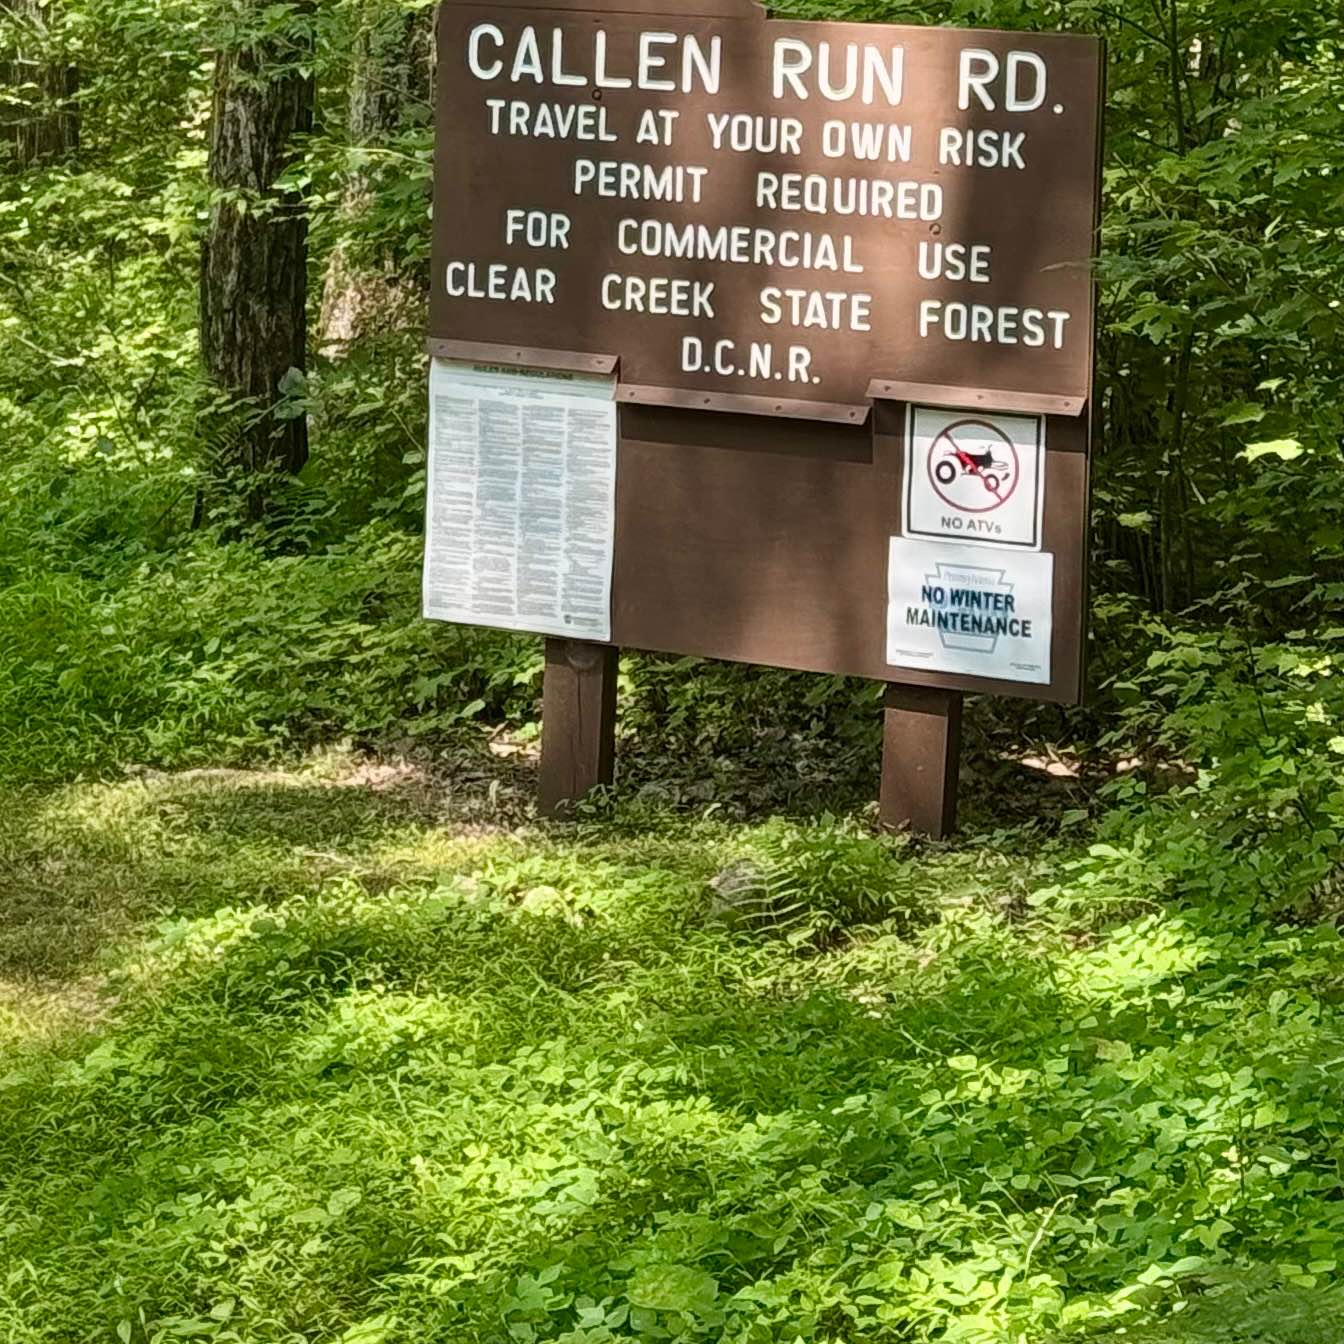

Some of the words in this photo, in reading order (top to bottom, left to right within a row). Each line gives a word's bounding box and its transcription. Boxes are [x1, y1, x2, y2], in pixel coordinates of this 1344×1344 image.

[469, 24, 721, 94] CALLEN
[774, 39, 904, 105] RUN
[958, 48, 1062, 113] RD.
[487, 100, 617, 141] TRAVEL
[637, 110, 679, 145] AT
[708, 113, 802, 154] YOUR
[823, 121, 911, 161] OWN
[939, 127, 1024, 168] RISK
[575, 160, 707, 202] PERMIT
[757, 173, 942, 220] REQUIRED
[507, 210, 570, 248] FOR
[619, 220, 864, 272] COMMERCIAL
[918, 241, 989, 282] USE
[447, 262, 555, 303] CLEAR
[602, 274, 713, 317] CREEK
[761, 288, 871, 330] STATE
[920, 300, 1069, 348] FOREST
[683, 337, 819, 383] D.C.N.R.
[941, 516, 963, 529] NO
[967, 519, 1002, 534] ATVs
[906, 607, 1033, 638] MAINTENANCE
[922, 585, 945, 605] NO
[950, 588, 1015, 612] WINTER
